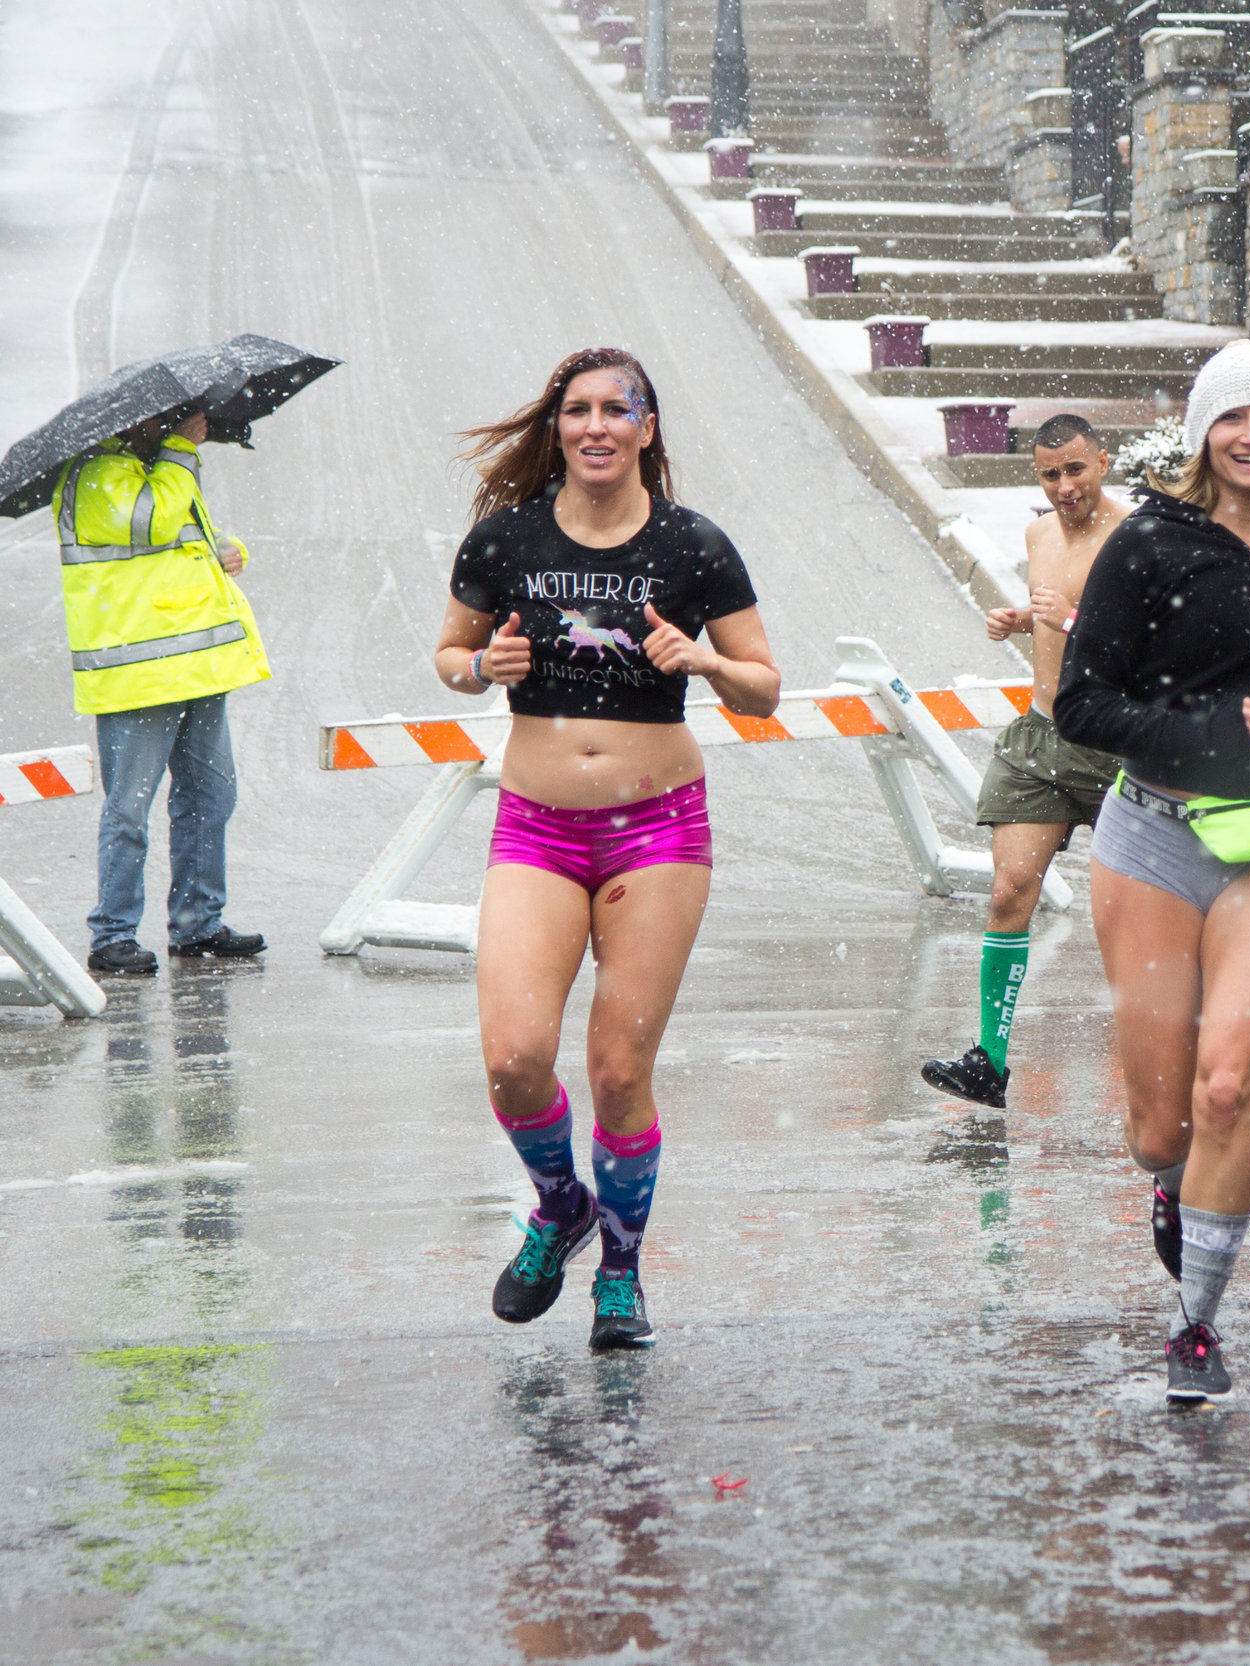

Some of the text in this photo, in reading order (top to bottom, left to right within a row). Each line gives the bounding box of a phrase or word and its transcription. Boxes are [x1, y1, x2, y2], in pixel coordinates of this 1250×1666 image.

[525, 571, 664, 604] MOTHER OF
[996, 963, 1025, 1039] BEER
